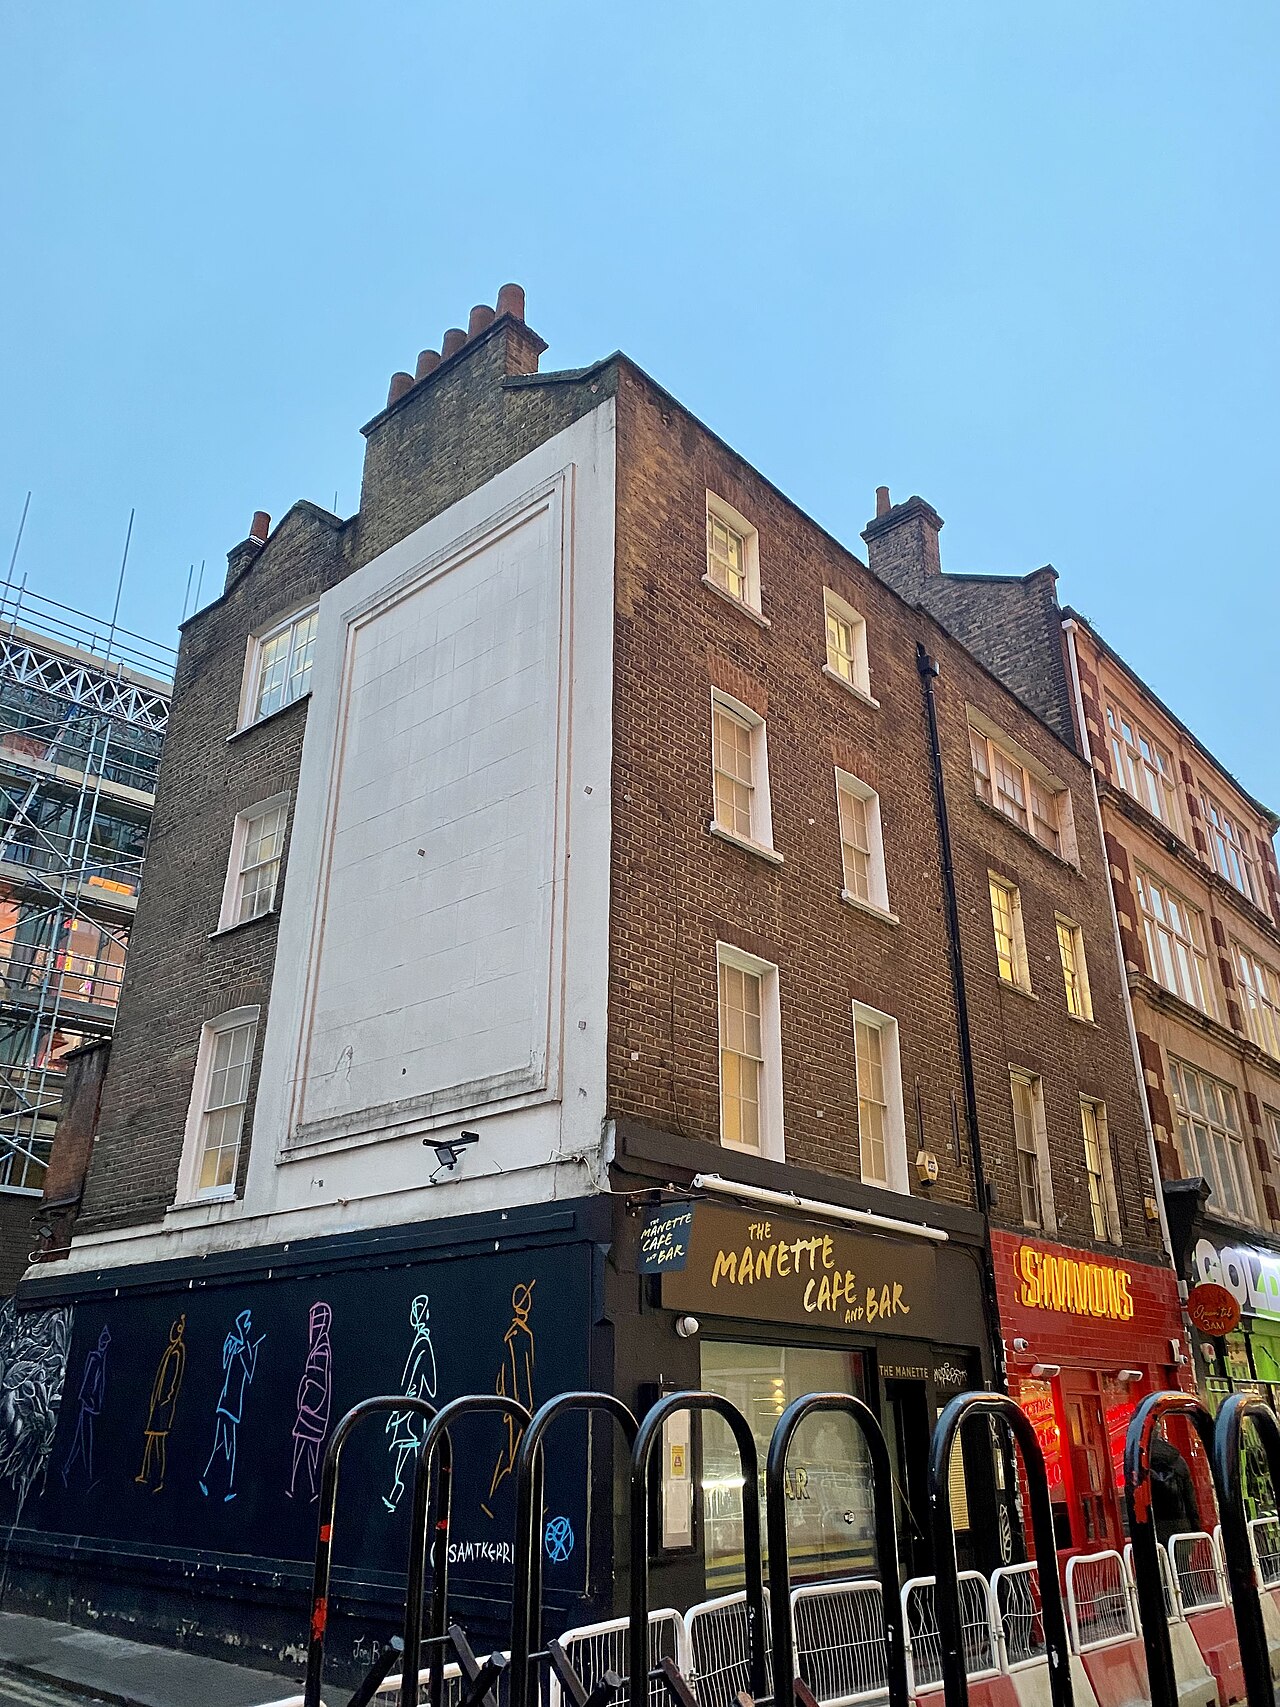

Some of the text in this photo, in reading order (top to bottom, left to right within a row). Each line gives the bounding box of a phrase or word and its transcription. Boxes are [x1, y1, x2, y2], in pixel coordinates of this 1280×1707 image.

[640, 1212, 692, 1240] MANETTE
[748, 1222, 771, 1241] THE
[642, 1232, 673, 1252] CAFE
[657, 1244, 685, 1265] BAR
[711, 1234, 834, 1288] MANETTE
[803, 1270, 857, 1313] CAFE
[1018, 1245, 1134, 1321] SIMMONS
[844, 1281, 910, 1324] AND BAR
[879, 1364, 894, 1377] THE
[895, 1366, 929, 1379] MANETTE
